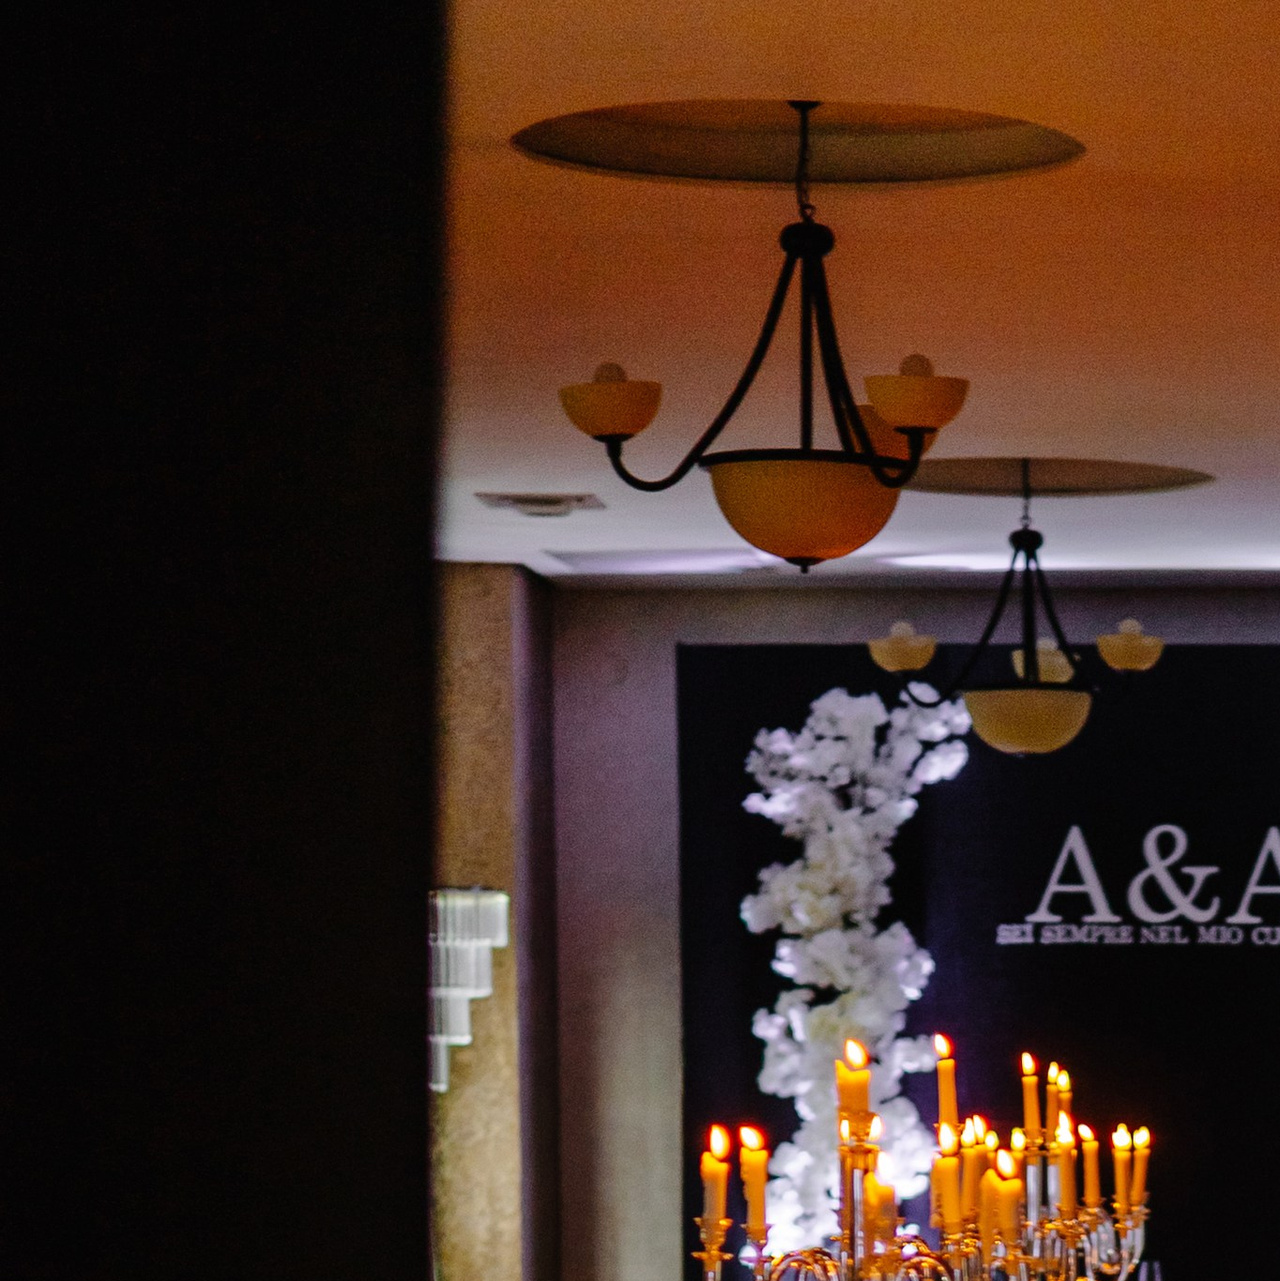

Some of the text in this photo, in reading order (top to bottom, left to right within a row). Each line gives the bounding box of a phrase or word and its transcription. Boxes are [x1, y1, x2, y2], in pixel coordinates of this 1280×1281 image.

[1040, 924, 1133, 944] SEMPRE
[1140, 925, 1190, 944] NEL
[1198, 925, 1244, 944] MIO
